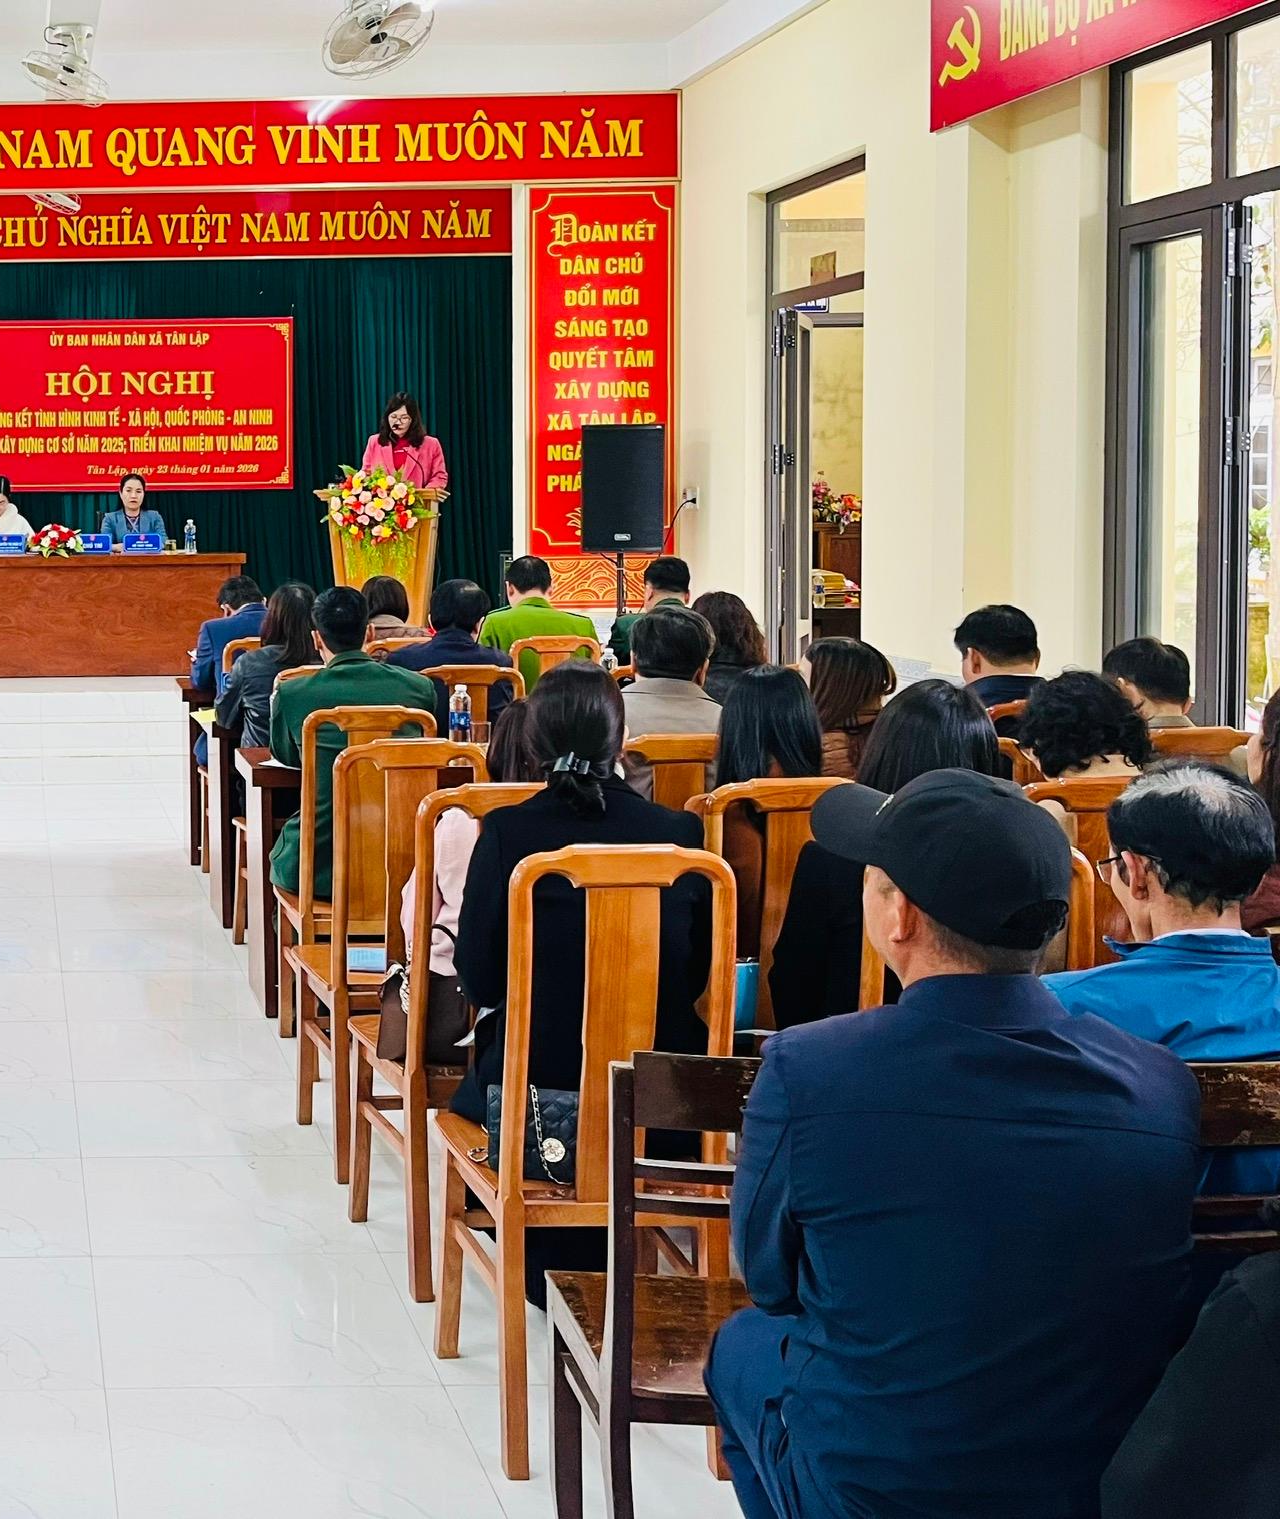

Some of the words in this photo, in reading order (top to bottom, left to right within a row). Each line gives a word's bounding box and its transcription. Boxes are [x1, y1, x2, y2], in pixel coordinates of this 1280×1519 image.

[106, 126, 256, 175] QUANG
[267, 122, 380, 164] VINH
[395, 110, 526, 161] MUÔN
[540, 109, 643, 158] NĂM
[57, 206, 152, 246] NGHĨA
[158, 205, 230, 251] VIỆT
[241, 212, 310, 242] NAM
[320, 202, 410, 240] MUÔN
[421, 201, 492, 238] NĂM
[547, 213, 618, 257] ĐOÀN
[621, 218, 657, 242] KẾT
[558, 254, 600, 276] DÂN
[605, 252, 643, 275] CHỦ
[564, 282, 597, 307] ĐỔI
[602, 285, 639, 306] MỚI
[49, 330, 64, 347] ỦY
[66, 334, 89, 347] BAN
[91, 331, 121, 346] NHÂN
[124, 331, 146, 346] DÂN
[148, 331, 163, 346] XÃ
[165, 330, 187, 346] TÂN
[189, 330, 210, 348] LẬP
[554, 316, 607, 338] SÁNG
[612, 318, 648, 340] TẠO
[549, 345, 609, 371] QUYẾT
[612, 347, 654, 368] TÂM
[46, 365, 111, 402] HỘI
[122, 371, 214, 400] NGHỊ
[554, 379, 592, 400] XÂY
[597, 380, 649, 402] DỰNG
[14, 407, 33, 428] KẾT
[34, 408, 57, 428] TÌNH
[58, 408, 82, 428] HÌNH
[83, 410, 107, 427] KINH
[107, 405, 121, 427] TẾ
[128, 407, 142, 427] XÃ
[143, 407, 163, 430] HỘI,
[164, 404, 190, 428] QUỐC
[191, 405, 225, 427] PHÒNG
[232, 409, 247, 426] AN
[248, 409, 273, 425] NINH
[547, 410, 573, 431] XÃ
[578, 409, 617, 426] TÂN
[18, 436, 45, 457] DỰNG
[46, 436, 60, 454] CƠ
[61, 432, 75, 454] SỞ
[76, 434, 99, 453] NĂM
[100, 436, 128, 455] 2025;
[128, 430, 157, 453] TRIỂN
[158, 436, 181, 452] KHAI
[182, 432, 214, 455] NHIỆM
[215, 435, 229, 455] VỤ
[230, 432, 253, 452] NĂM
[254, 435, 279, 451] 2026
[87, 465, 106, 475] Tân
[107, 465, 129, 477] Lập,
[156, 464, 169, 474] 23
[170, 464, 199, 476] tháng
[199, 464, 211, 474] 01
[236, 463, 260, 473] 2026
[547, 471, 582, 492] PHÁ
